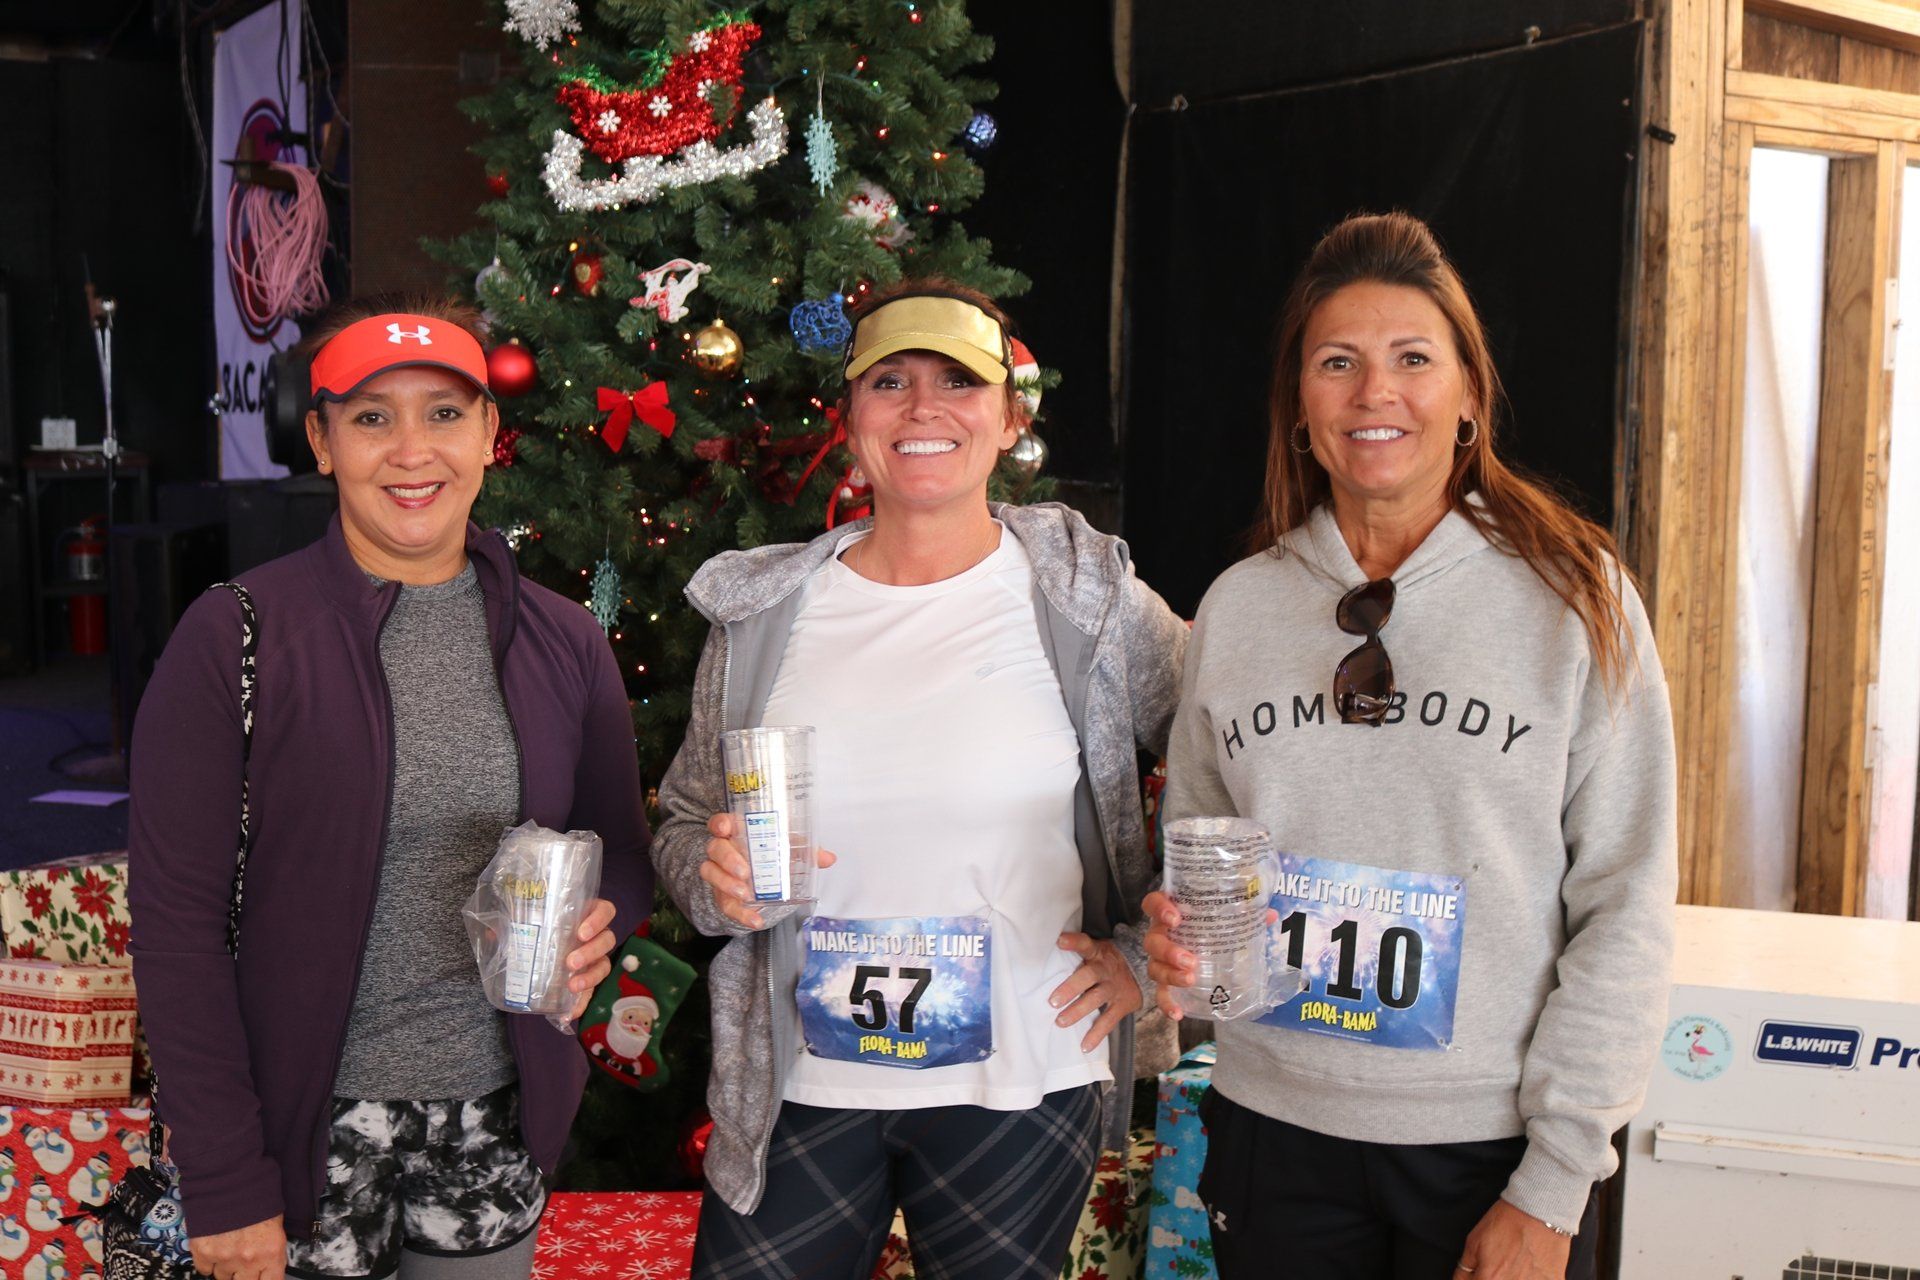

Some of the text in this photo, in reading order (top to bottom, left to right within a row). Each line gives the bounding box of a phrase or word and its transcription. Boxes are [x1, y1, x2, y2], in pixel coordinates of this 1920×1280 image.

[1273, 872, 1311, 900] AKE
[1314, 878, 1334, 904] IT
[1337, 882, 1363, 908] TO
[1367, 887, 1405, 915] THE
[1410, 892, 1459, 920] LINE
[810, 930, 986, 958] MAKE IT TO THE LINE
[1280, 911, 1423, 1010] 110
[849, 965, 932, 1034] 57
[1301, 1002, 1377, 1031] FLORA-BAMA
[859, 1036, 927, 1059] FLORA-BAMA
[1764, 1035, 1852, 1055] L.B.WHITE
